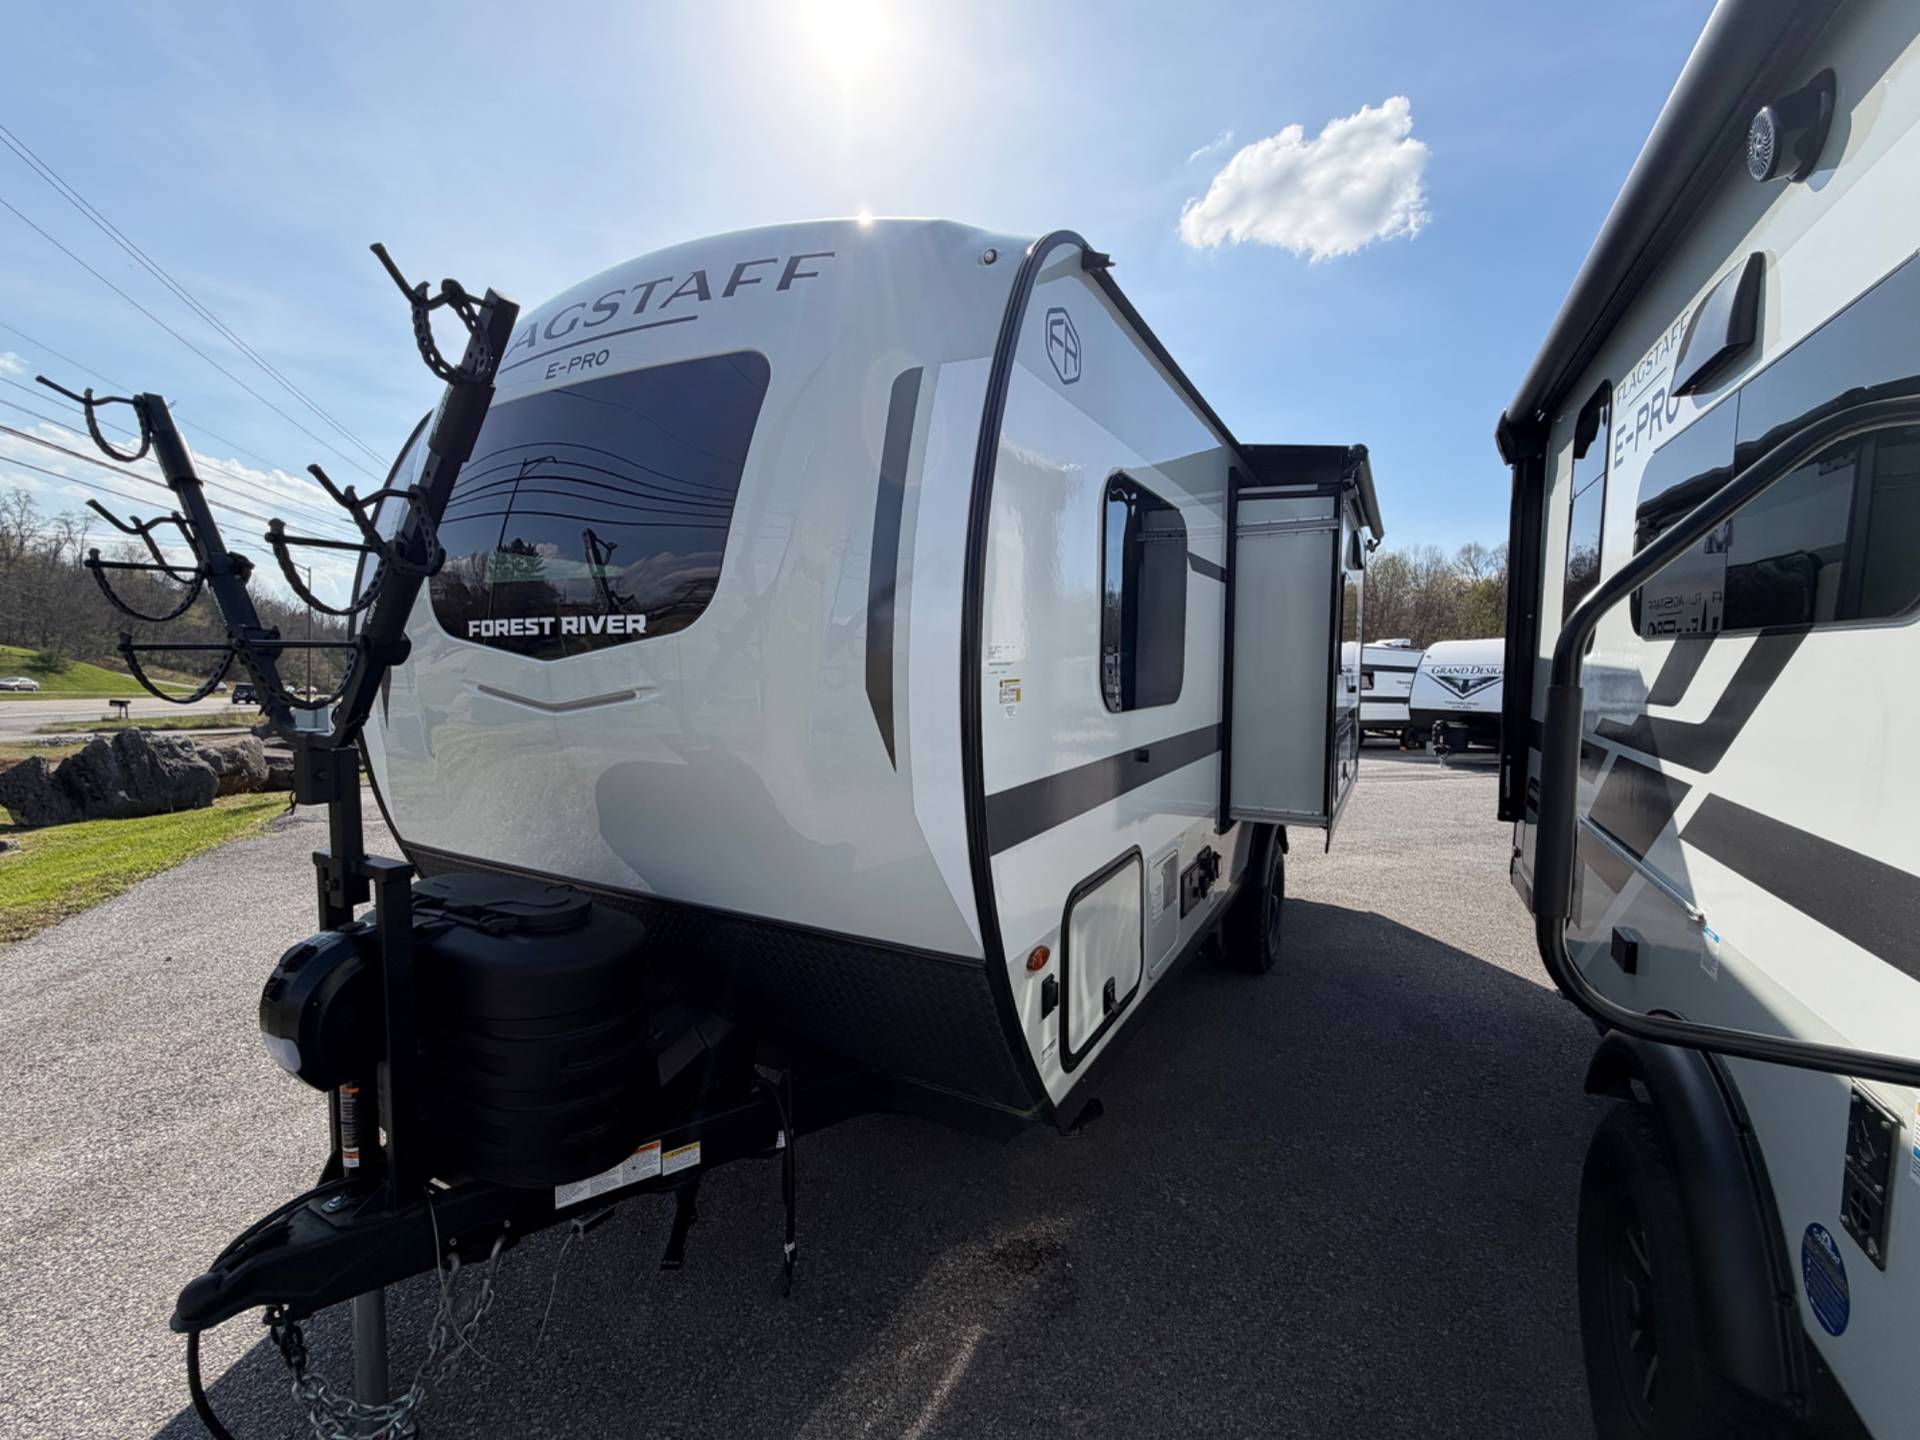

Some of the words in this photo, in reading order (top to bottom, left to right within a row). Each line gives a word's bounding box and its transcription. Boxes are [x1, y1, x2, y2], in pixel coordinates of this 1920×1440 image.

[504, 251, 835, 359] AGSTAFF
[545, 349, 610, 380] E-PRO
[1616, 311, 1690, 407] FLAGSTAFF
[468, 617, 556, 637] FOREST
[560, 614, 647, 635] RIVER
[1431, 665, 1469, 675] GRAND
[1470, 665, 1502, 675] DESIG
